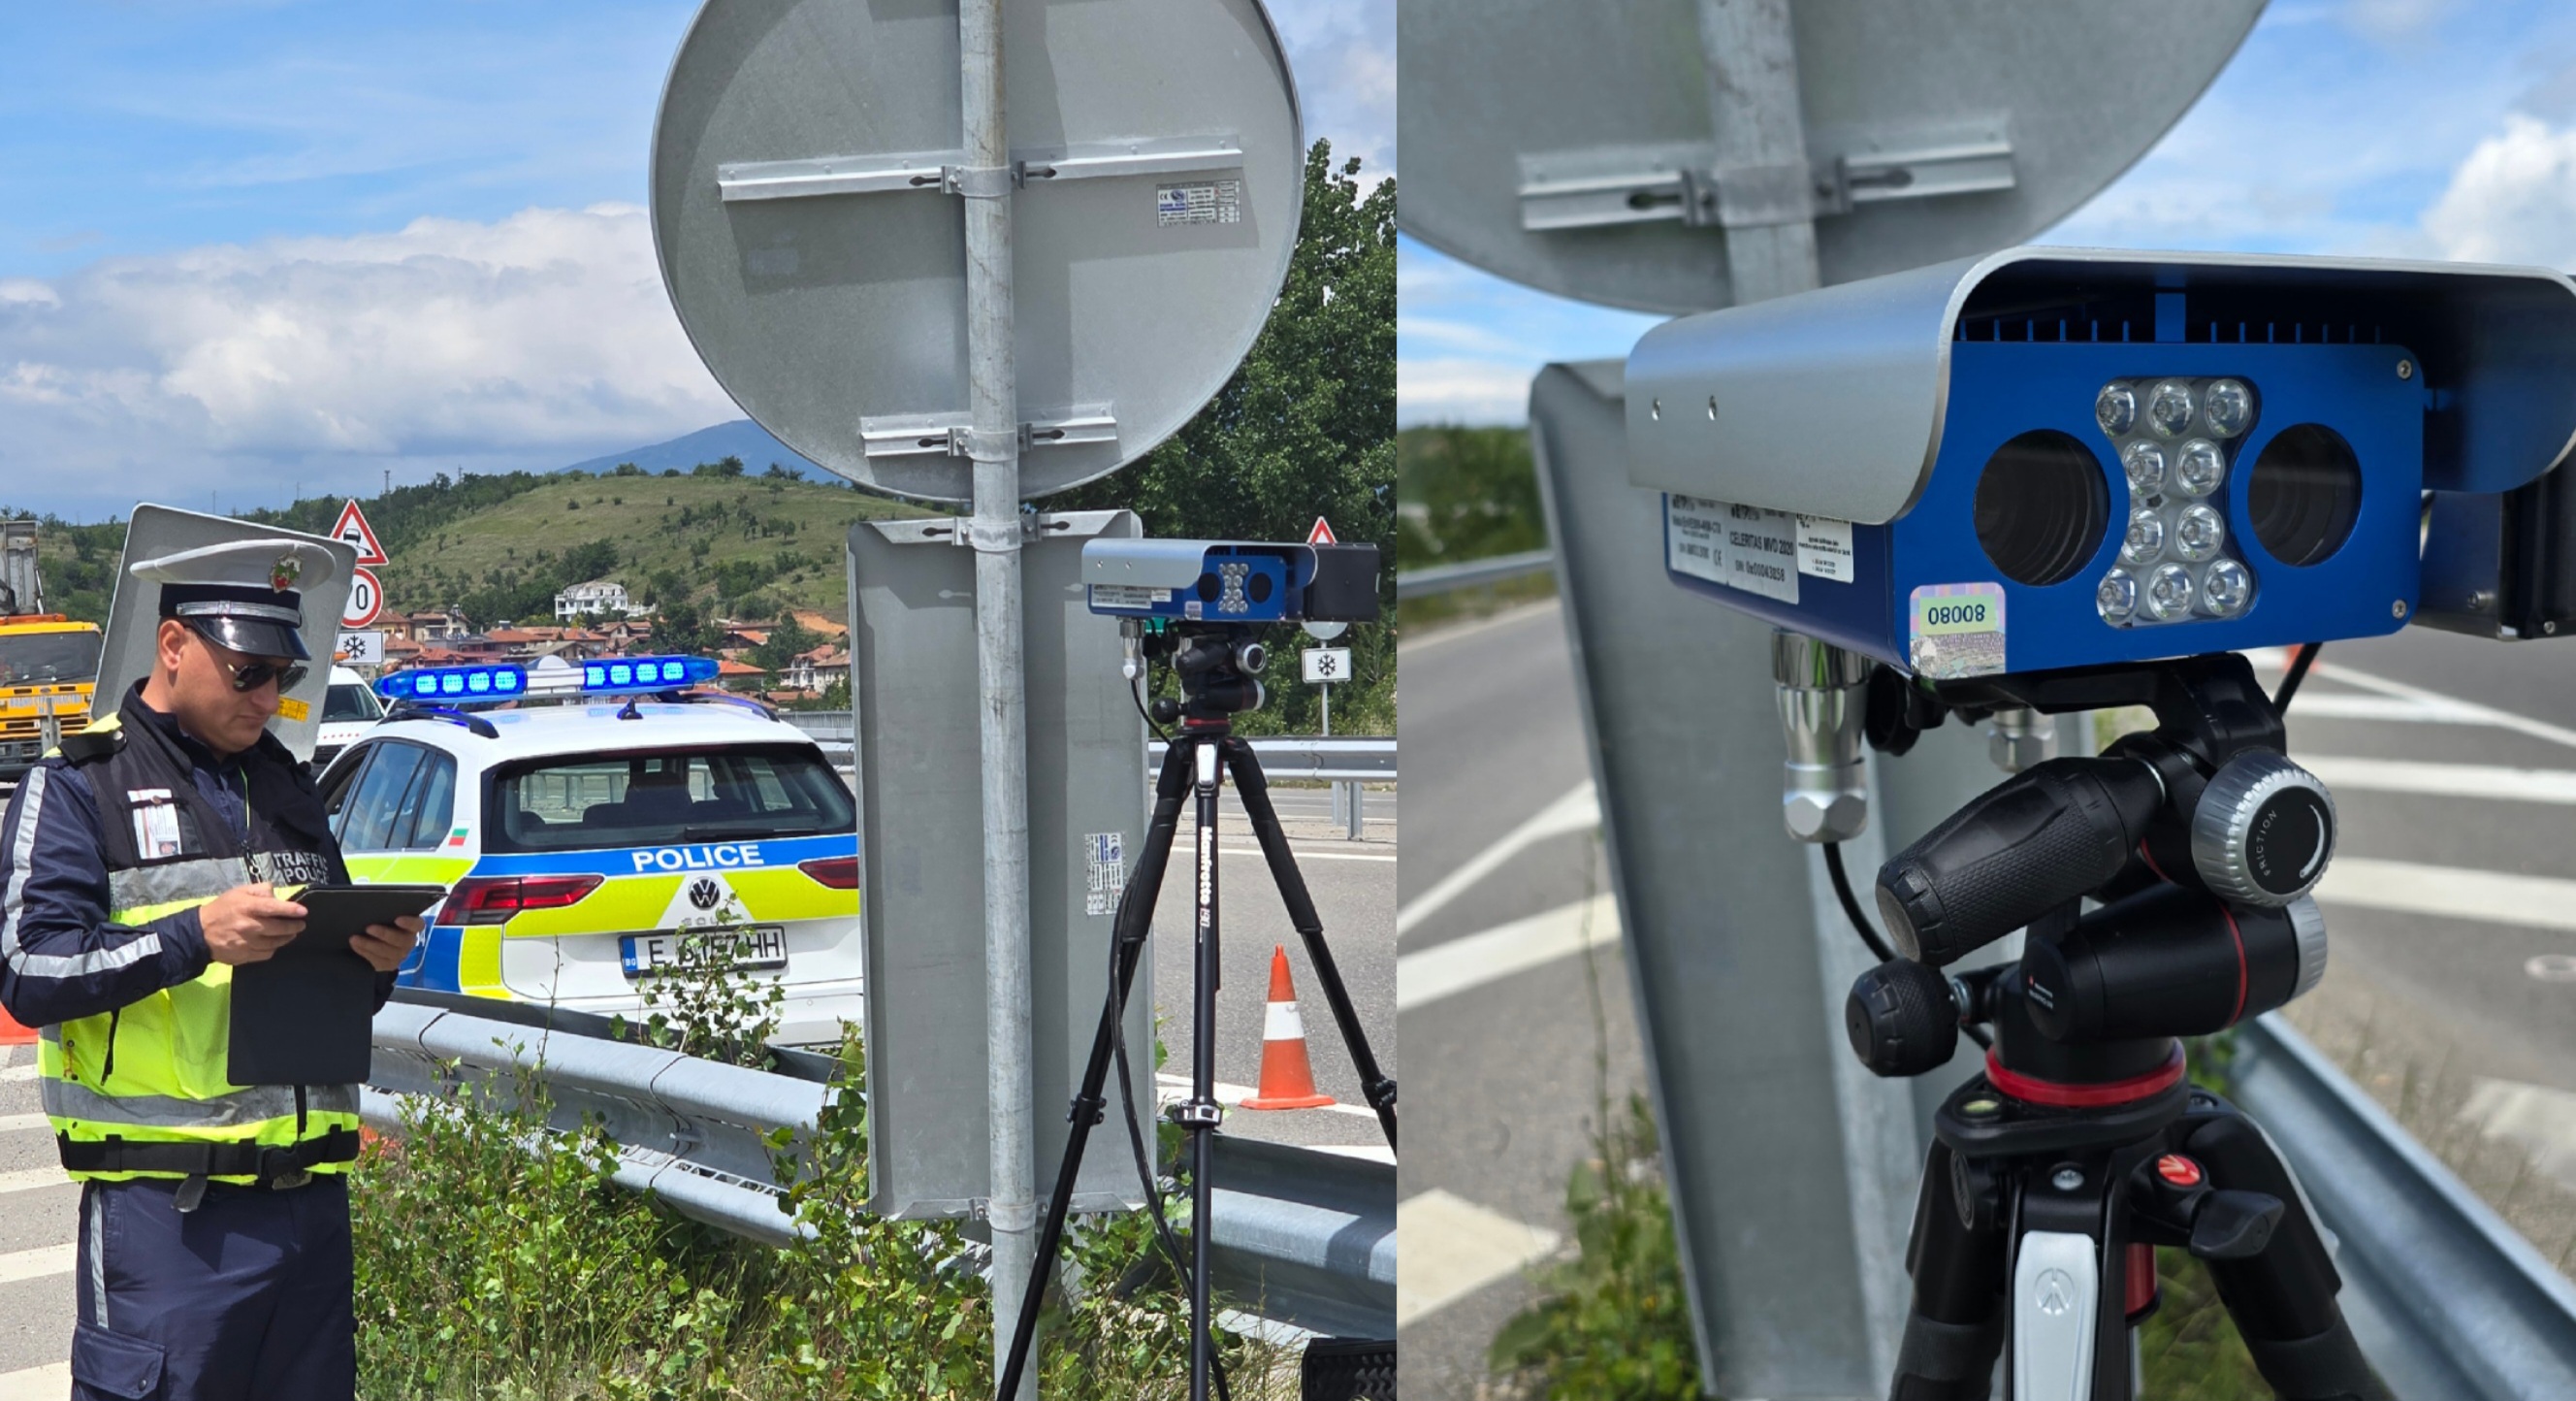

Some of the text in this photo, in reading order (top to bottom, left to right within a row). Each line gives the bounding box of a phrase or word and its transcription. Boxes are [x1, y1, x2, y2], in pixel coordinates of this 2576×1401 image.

[631, 843, 764, 872] POLICE
[2256, 809, 2277, 877] FRICTION
[282, 865, 330, 886] POLICE
[1200, 825, 1213, 905] Manfrotto
[648, 939, 666, 964] E
